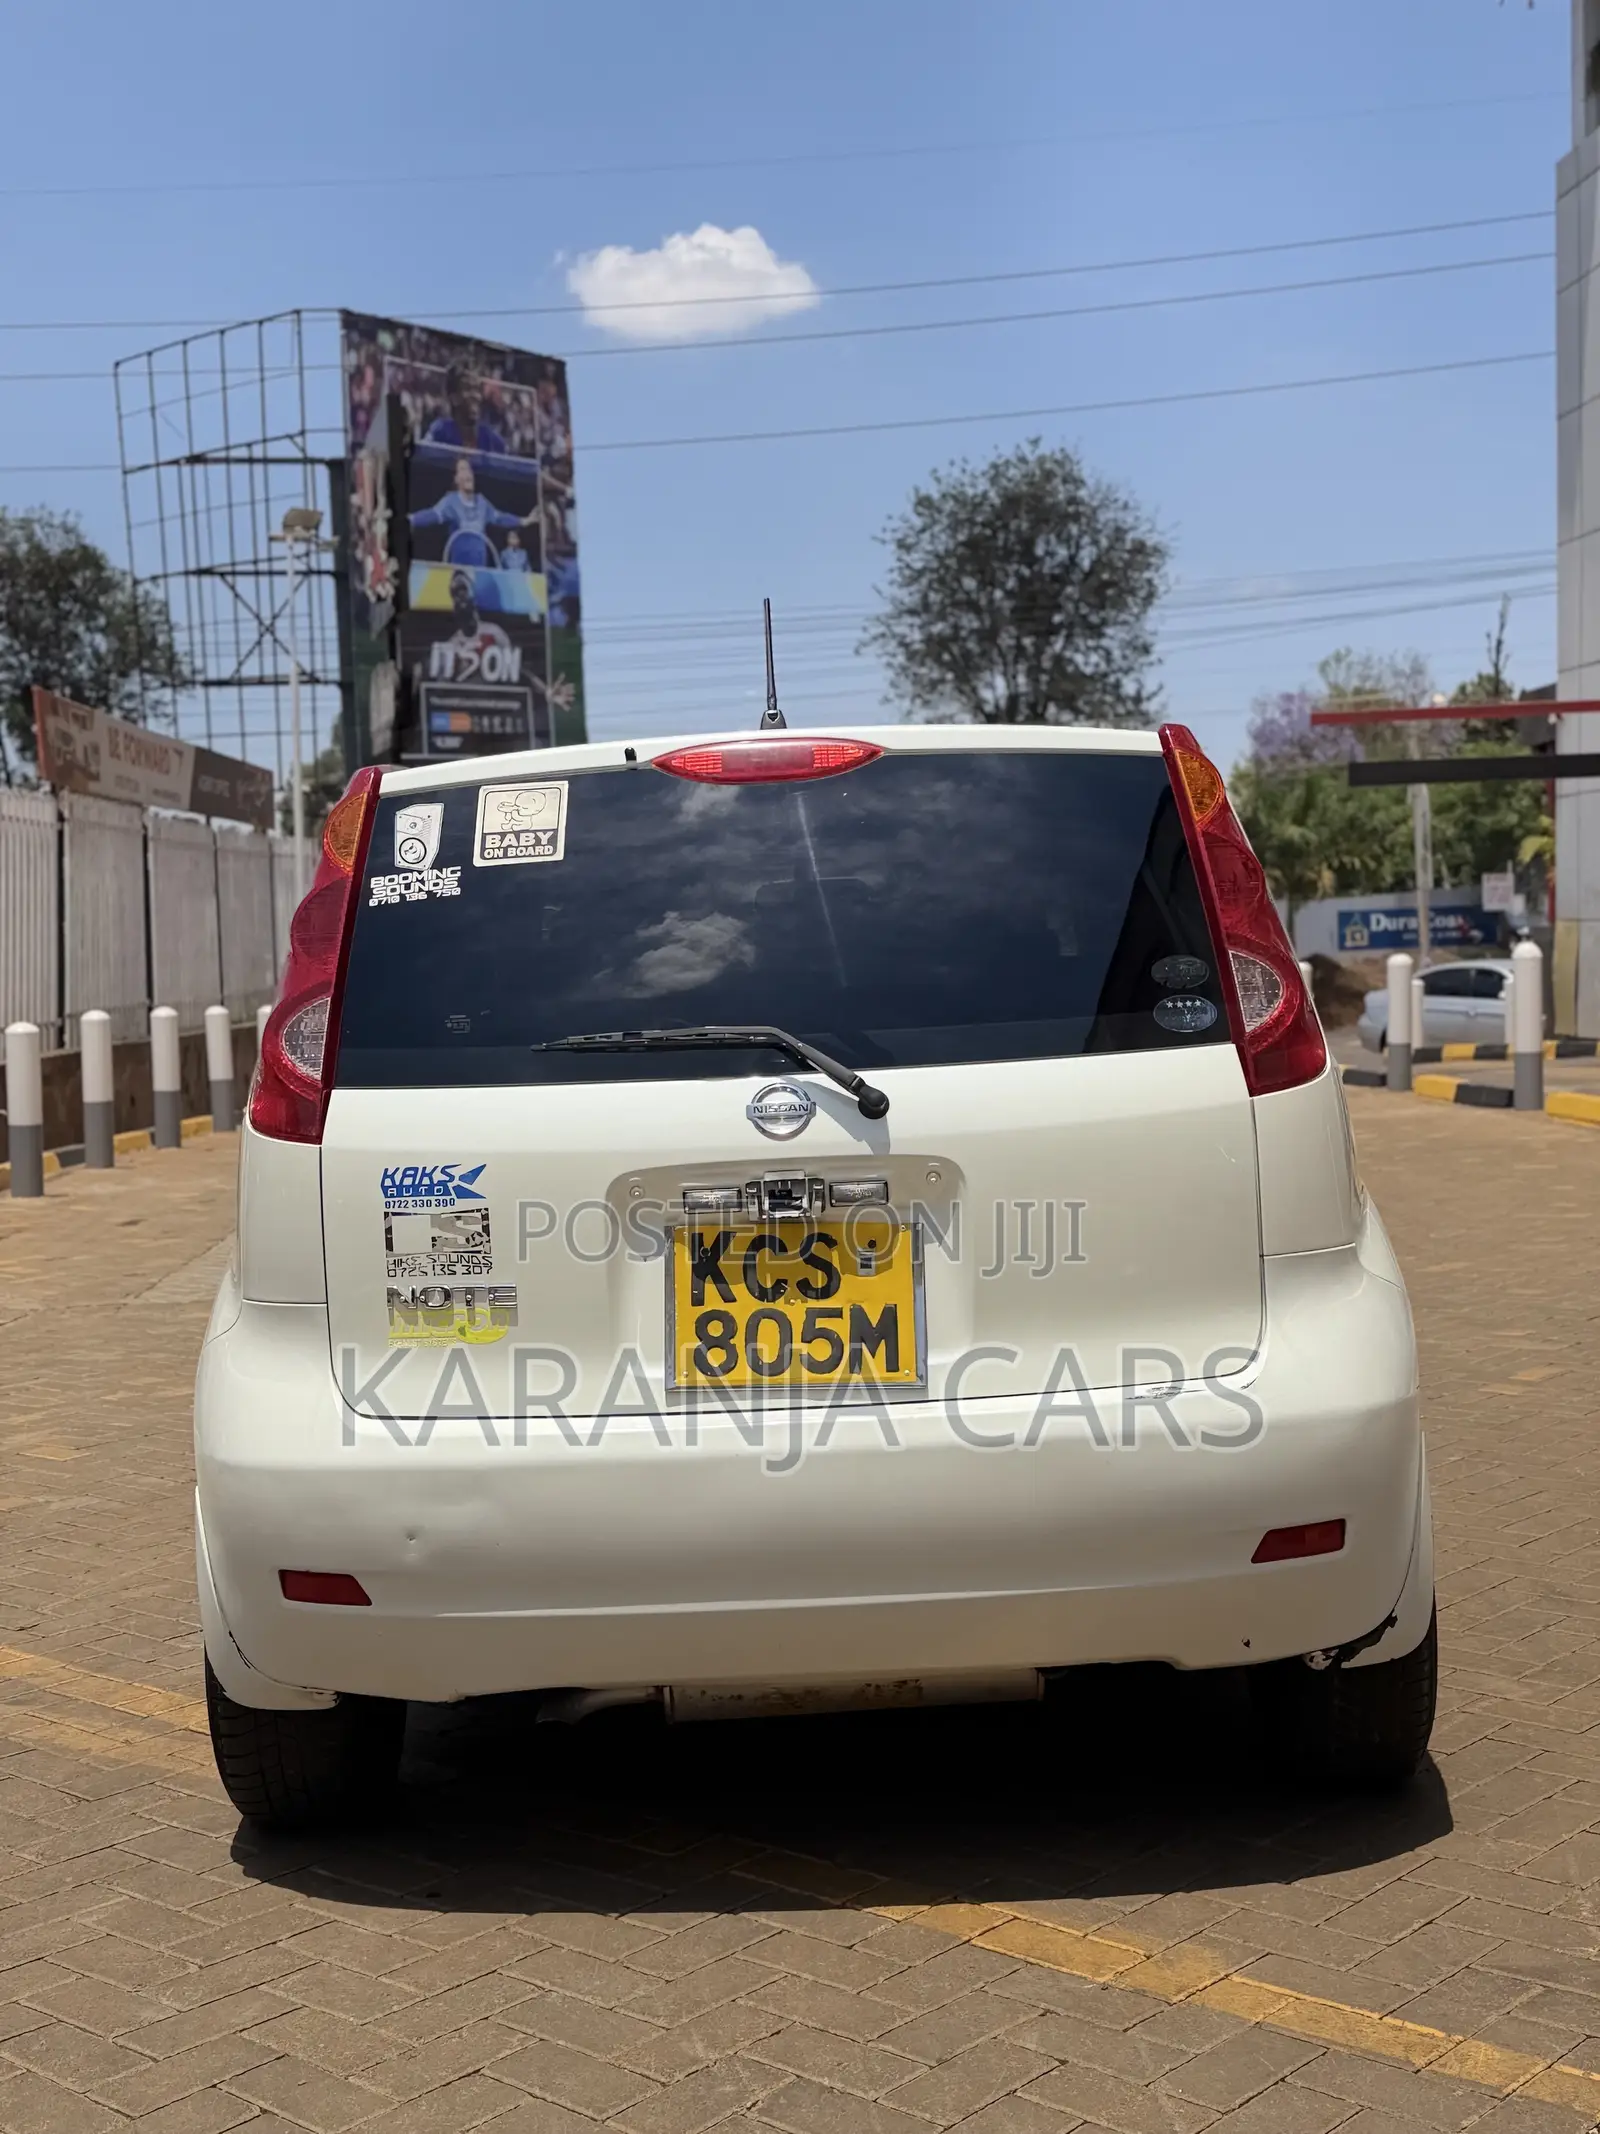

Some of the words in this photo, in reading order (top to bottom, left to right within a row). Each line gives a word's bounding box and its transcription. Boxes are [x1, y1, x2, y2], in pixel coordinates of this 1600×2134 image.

[485, 831, 554, 849] BABY
[483, 848, 504, 859] ON
[507, 844, 554, 858] BOARD
[370, 866, 461, 889] BOOMING
[368, 895, 400, 907] 0710
[435, 886, 461, 898] 750
[372, 877, 458, 899] SOUNDS
[752, 1102, 810, 1115] NISSAN
[381, 1164, 463, 1187] KAKS
[387, 1185, 445, 1197] AUTO
[384, 1200, 410, 1209] 0722
[411, 1199, 433, 1209] 330
[434, 1197, 456, 1208] 390
[425, 1253, 493, 1267] SOUNDS
[690, 1231, 842, 1306] KCS
[461, 1264, 493, 1276] 307
[386, 1284, 518, 1309] NOTE
[693, 1303, 900, 1378] 805M
